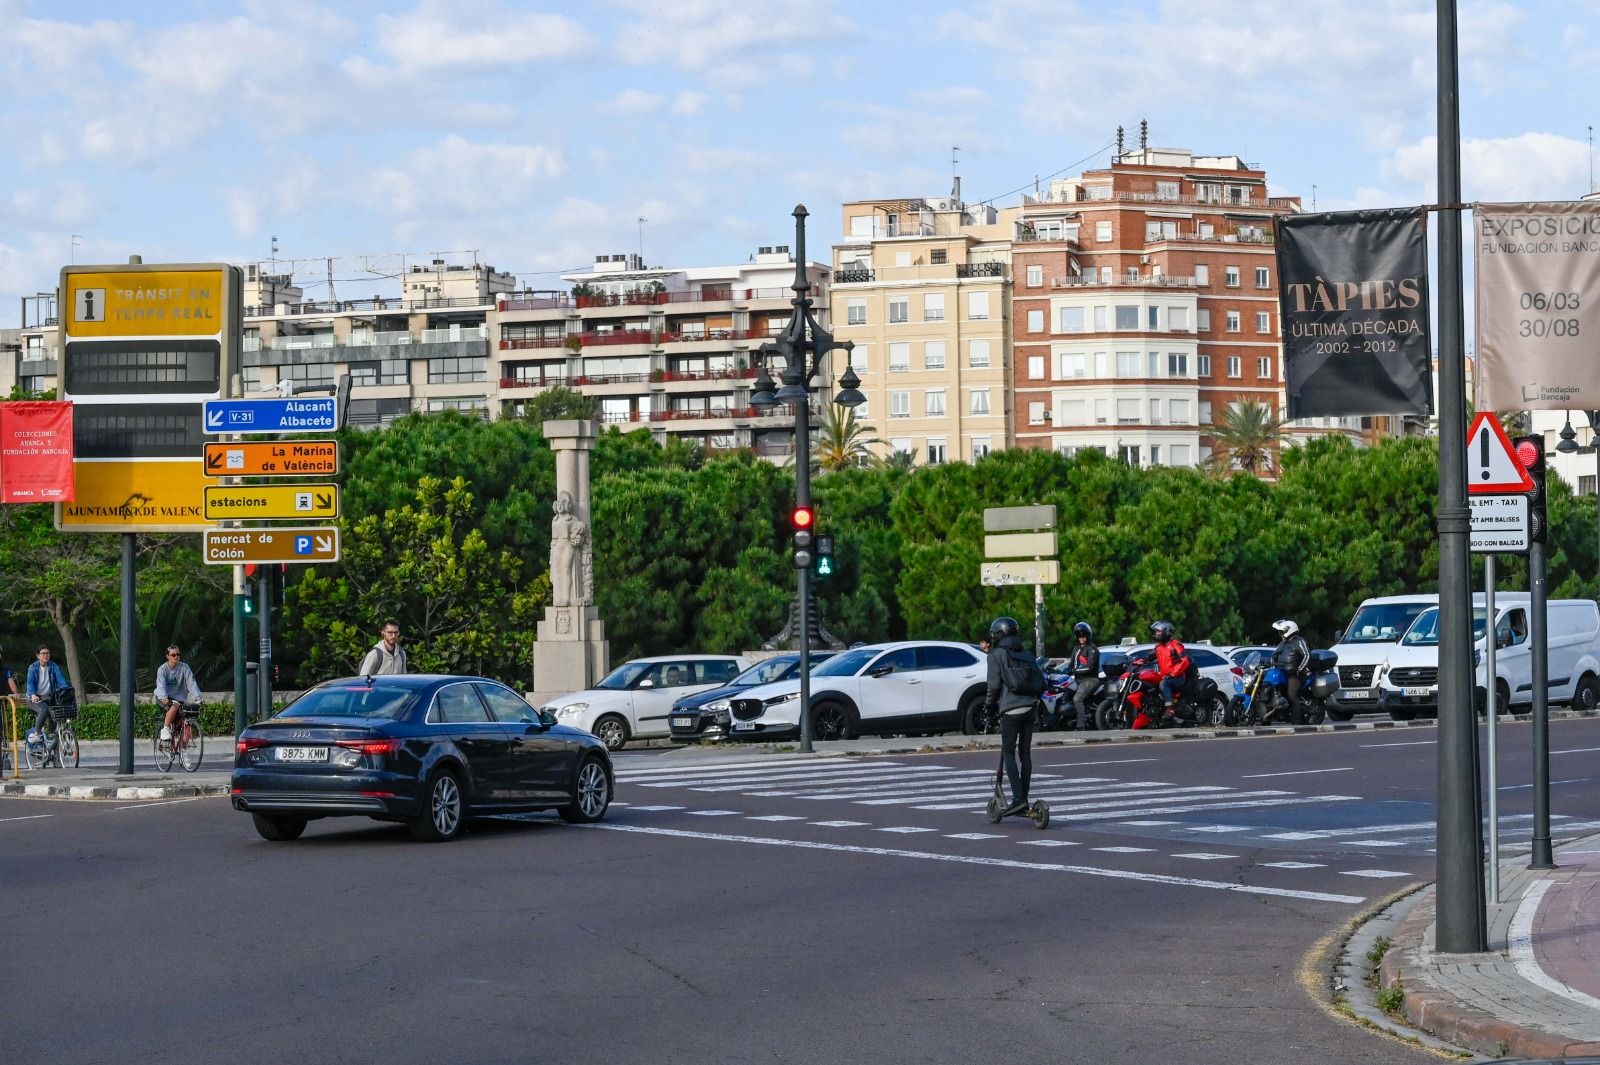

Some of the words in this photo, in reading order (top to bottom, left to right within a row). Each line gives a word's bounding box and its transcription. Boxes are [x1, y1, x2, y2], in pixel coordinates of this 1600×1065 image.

[1482, 240, 1558, 254] FUNDACIÓN
[1562, 241, 1600, 252] BANC
[189, 288, 210, 300] EN
[1288, 275, 1420, 312] TÀPIES
[1520, 292, 1580, 312] 06/03
[173, 307, 212, 319] REAL
[1292, 320, 1348, 337] ÚLTIMA
[1352, 318, 1420, 335] DÉCADA
[1519, 318, 1580, 339] 30/08
[1316, 342, 1350, 354] 2002
[1363, 340, 1397, 353] 2012
[1541, 385, 1580, 393] Fundación
[1541, 394, 1571, 402] Bancaja
[285, 401, 332, 412] Alacant
[231, 412, 252, 421] V-31
[279, 416, 332, 426] Albacete
[272, 446, 286, 457] La
[293, 445, 333, 456] Marina
[261, 461, 276, 471] de
[284, 460, 333, 470] València
[210, 496, 267, 507] estacions
[1479, 499, 1494, 507] EMT
[143, 506, 158, 516] DE
[210, 533, 251, 544] mercat
[258, 533, 273, 543] de
[298, 537, 309, 552] P
[210, 547, 245, 559] Colón
[282, 748, 304, 759] 6875
[307, 748, 326, 759] KMM
